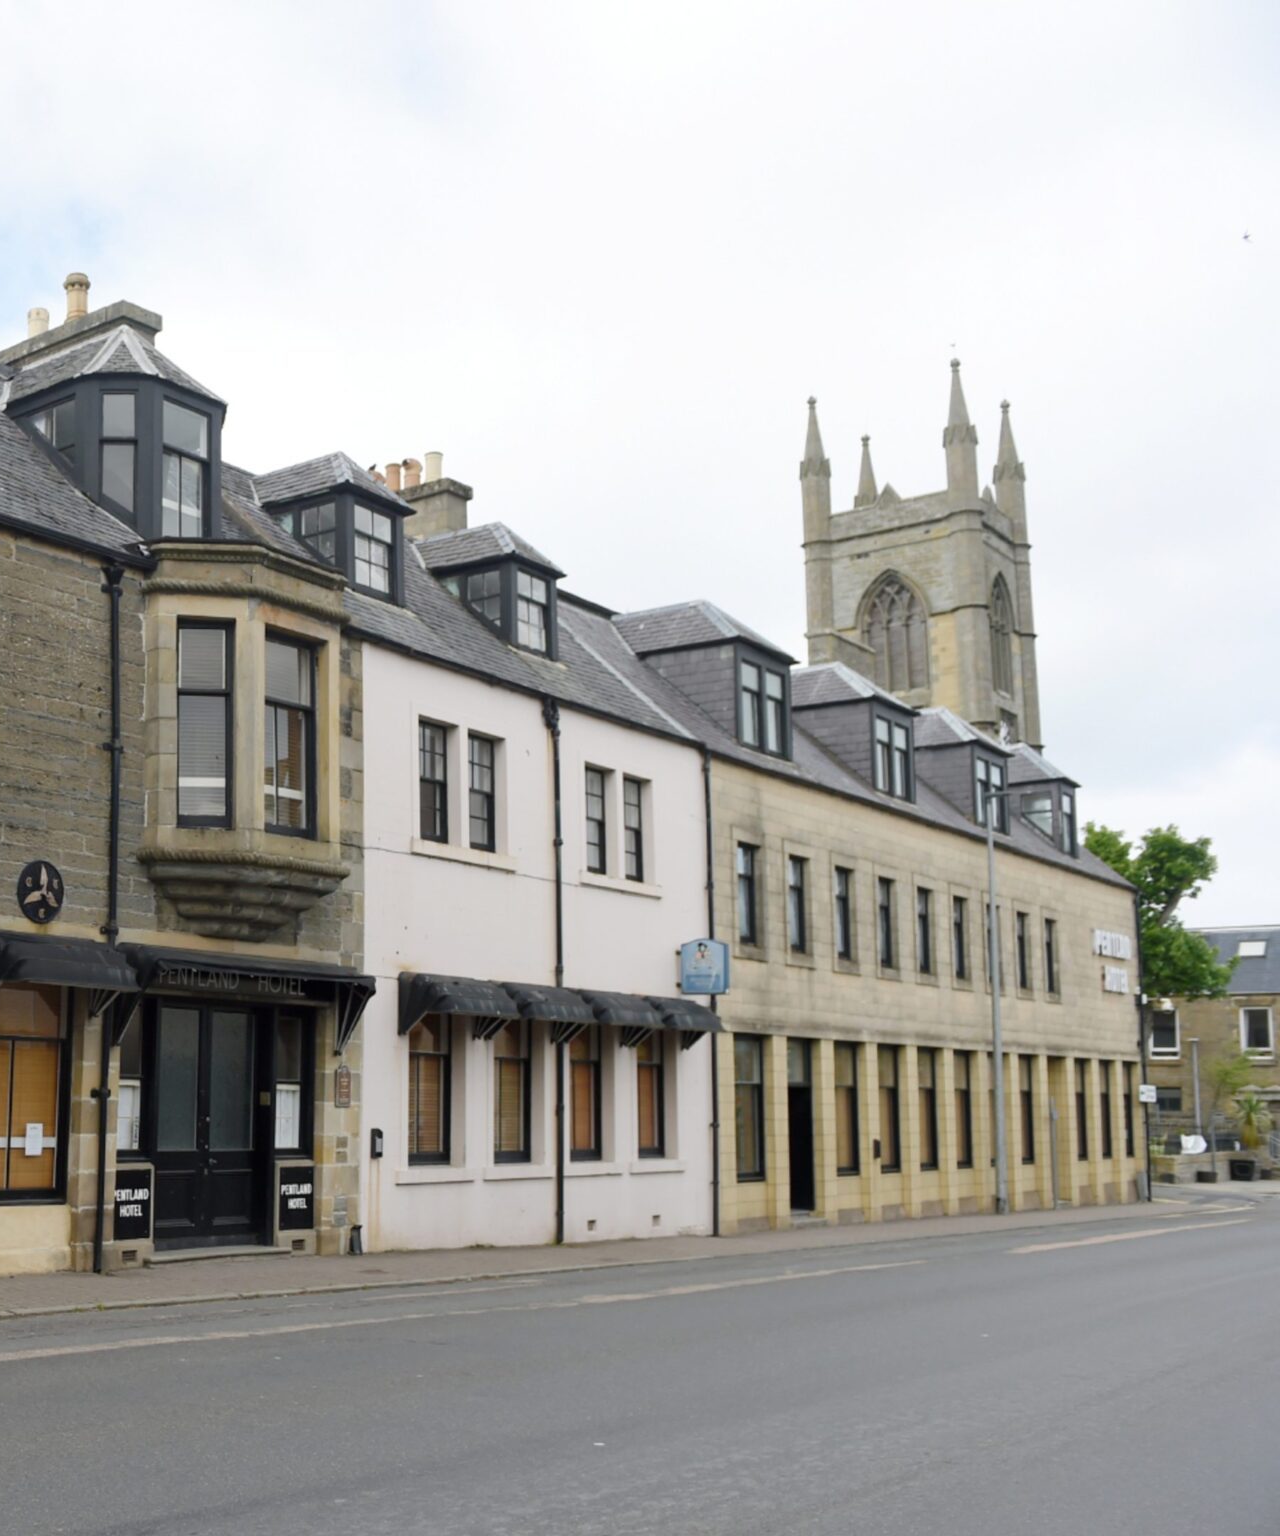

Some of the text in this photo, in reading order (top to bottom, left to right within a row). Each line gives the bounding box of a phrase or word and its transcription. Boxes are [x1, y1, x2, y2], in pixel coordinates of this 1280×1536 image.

[159, 967, 305, 996] PENTLAND HOTEL
[281, 1183, 312, 1196] PENTLAND
[287, 1197, 307, 1209] HOTEL
[119, 1204, 143, 1218] HOTEL
